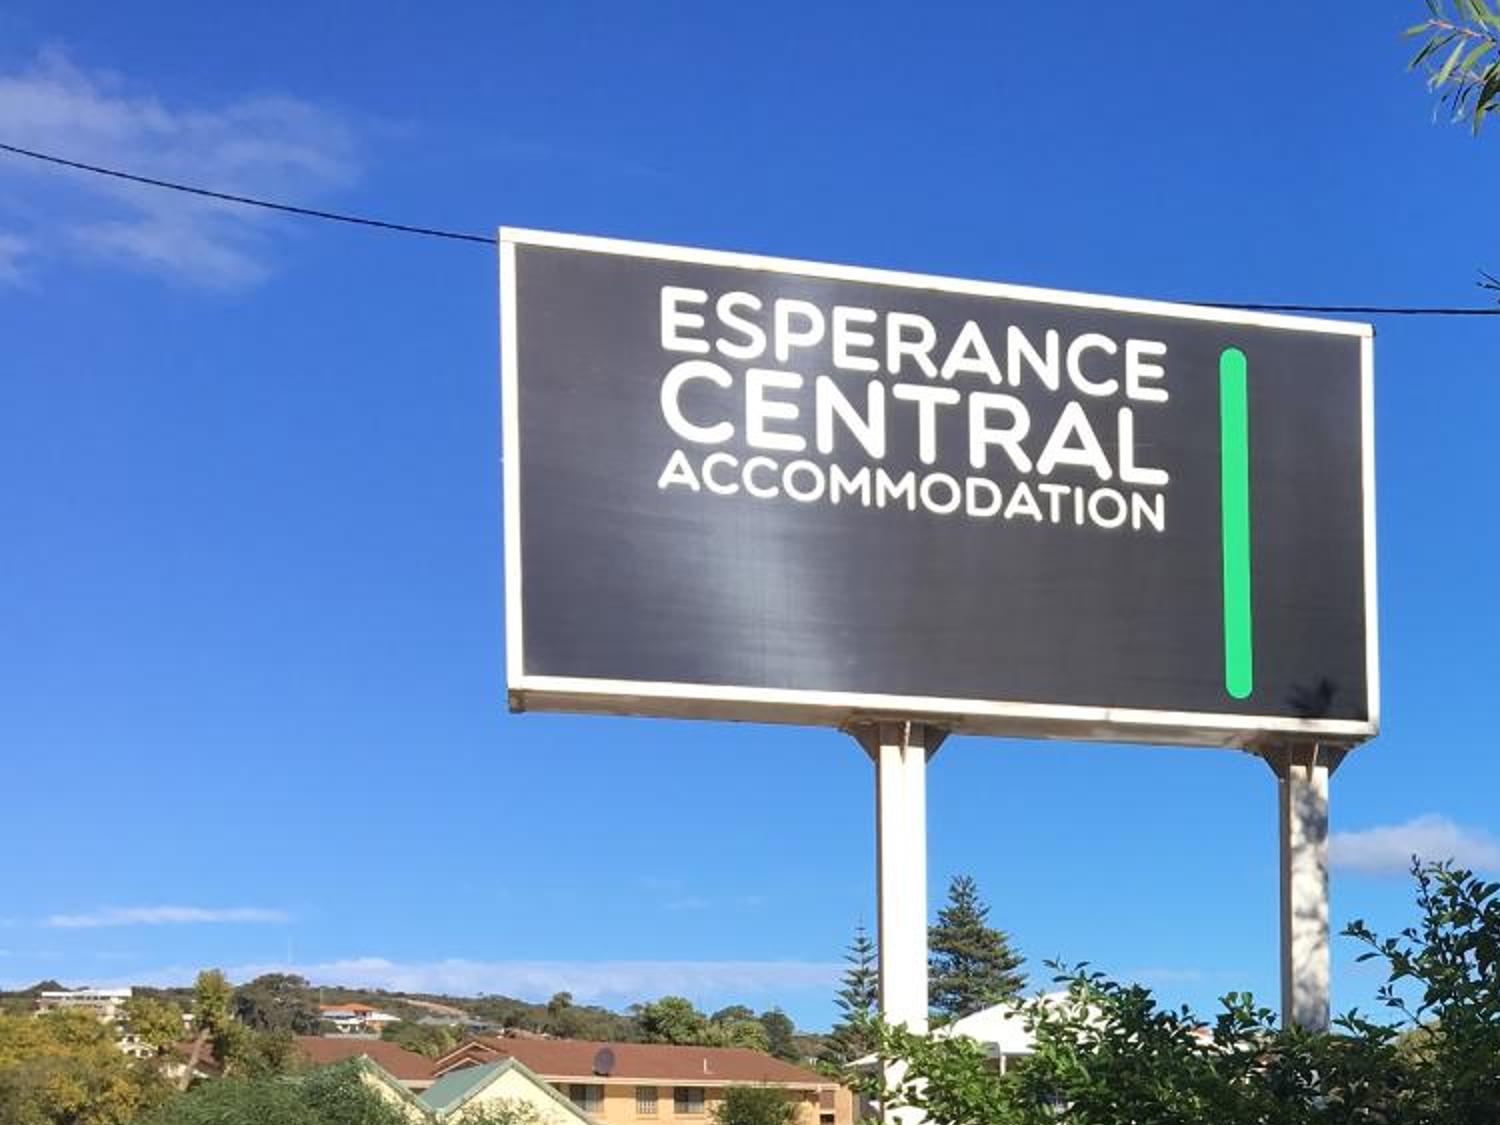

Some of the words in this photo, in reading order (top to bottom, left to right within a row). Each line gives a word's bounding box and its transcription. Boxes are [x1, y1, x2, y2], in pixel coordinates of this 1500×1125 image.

[660, 285, 1169, 403] ESPERANCE
[660, 360, 1170, 486] CENTRAL
[657, 449, 1166, 532] ACCOMMODATION
